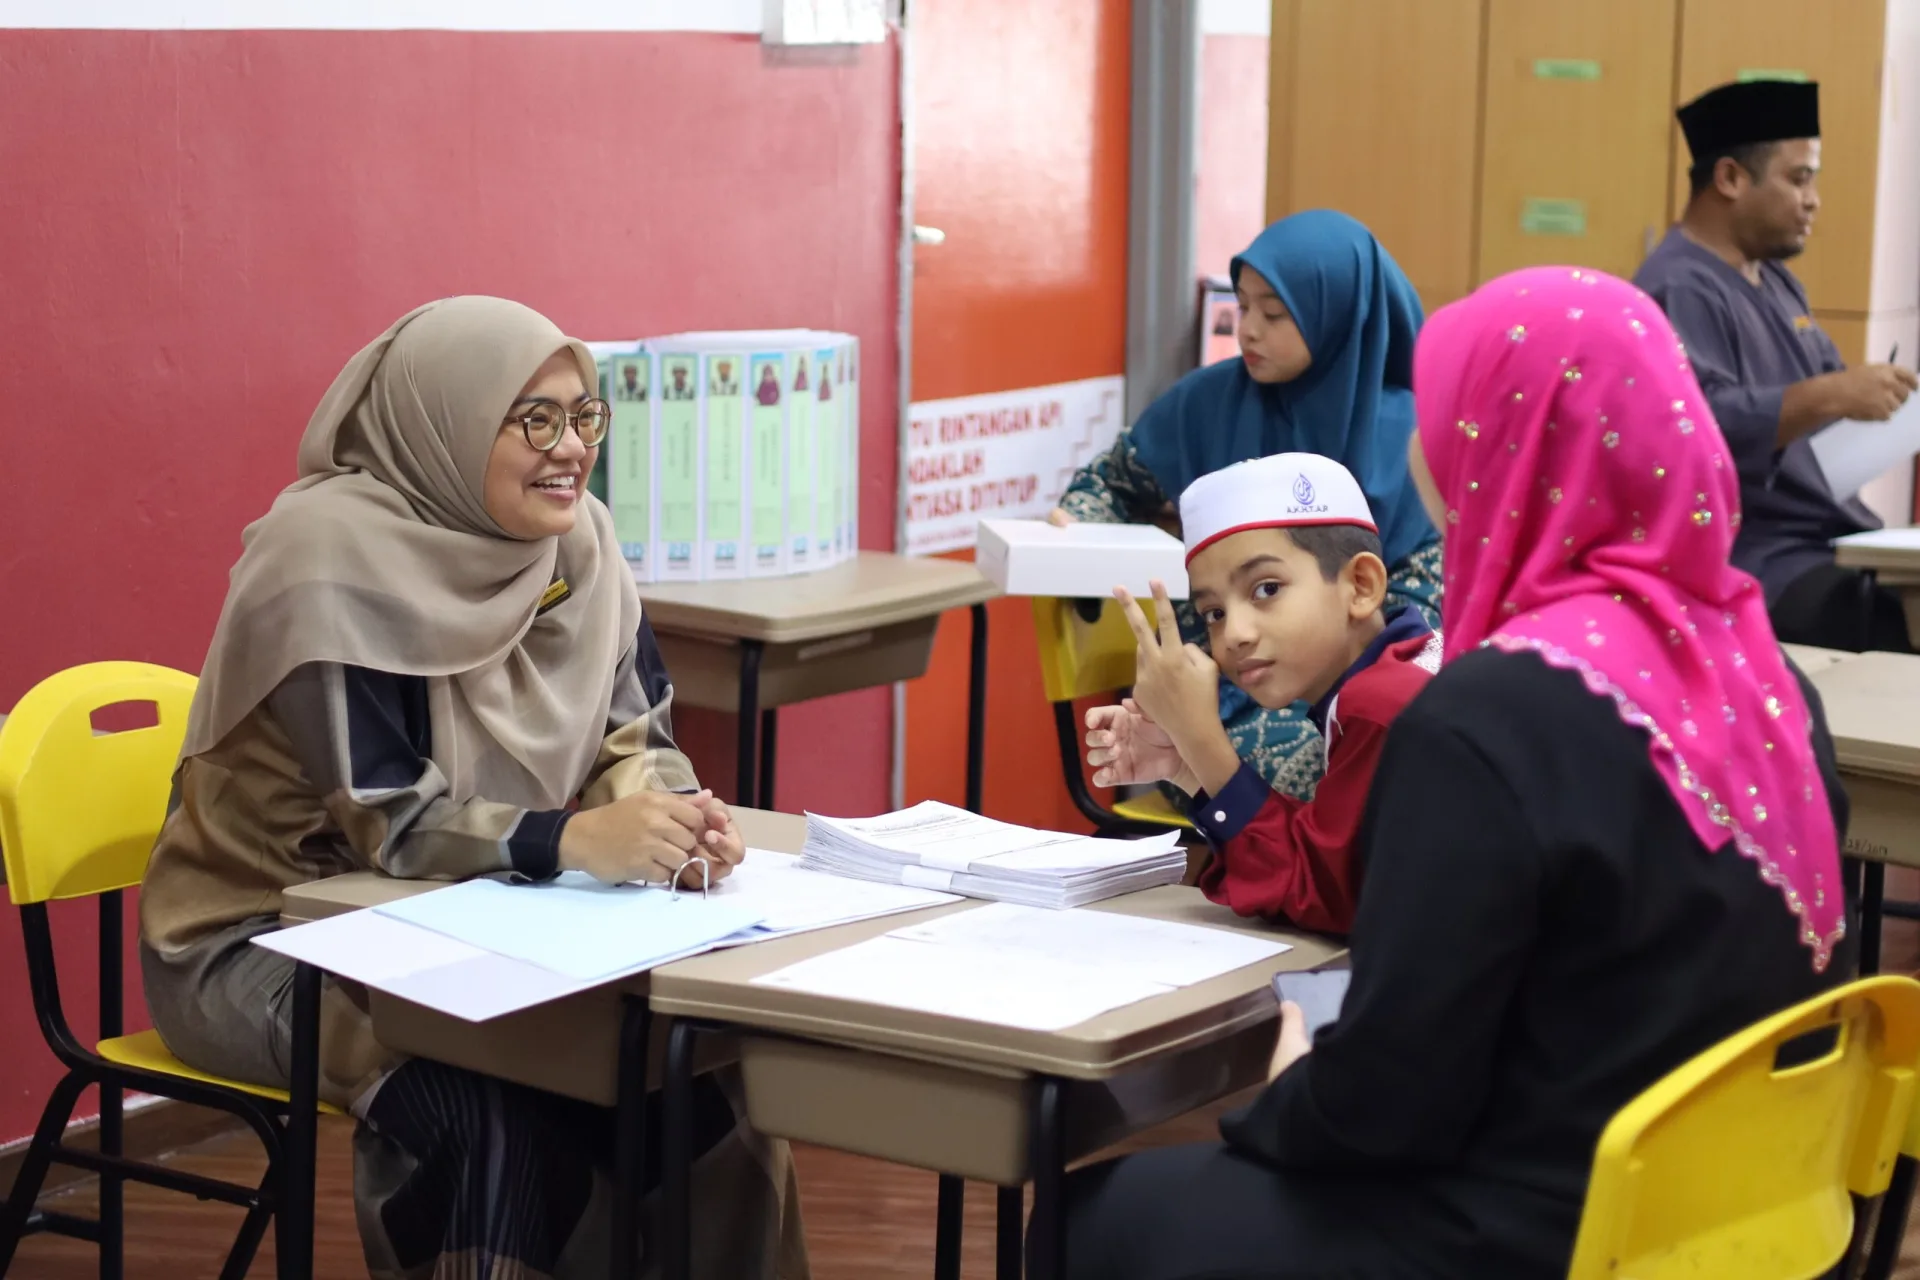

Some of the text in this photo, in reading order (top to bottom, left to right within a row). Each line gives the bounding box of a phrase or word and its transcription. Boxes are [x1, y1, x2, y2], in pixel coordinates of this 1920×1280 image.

[940, 407, 1031, 443] RINTANGAN
[1038, 400, 1063, 429] API
[969, 476, 1037, 511] DITUTUP
[1287, 504, 1329, 513] AKHTAR
